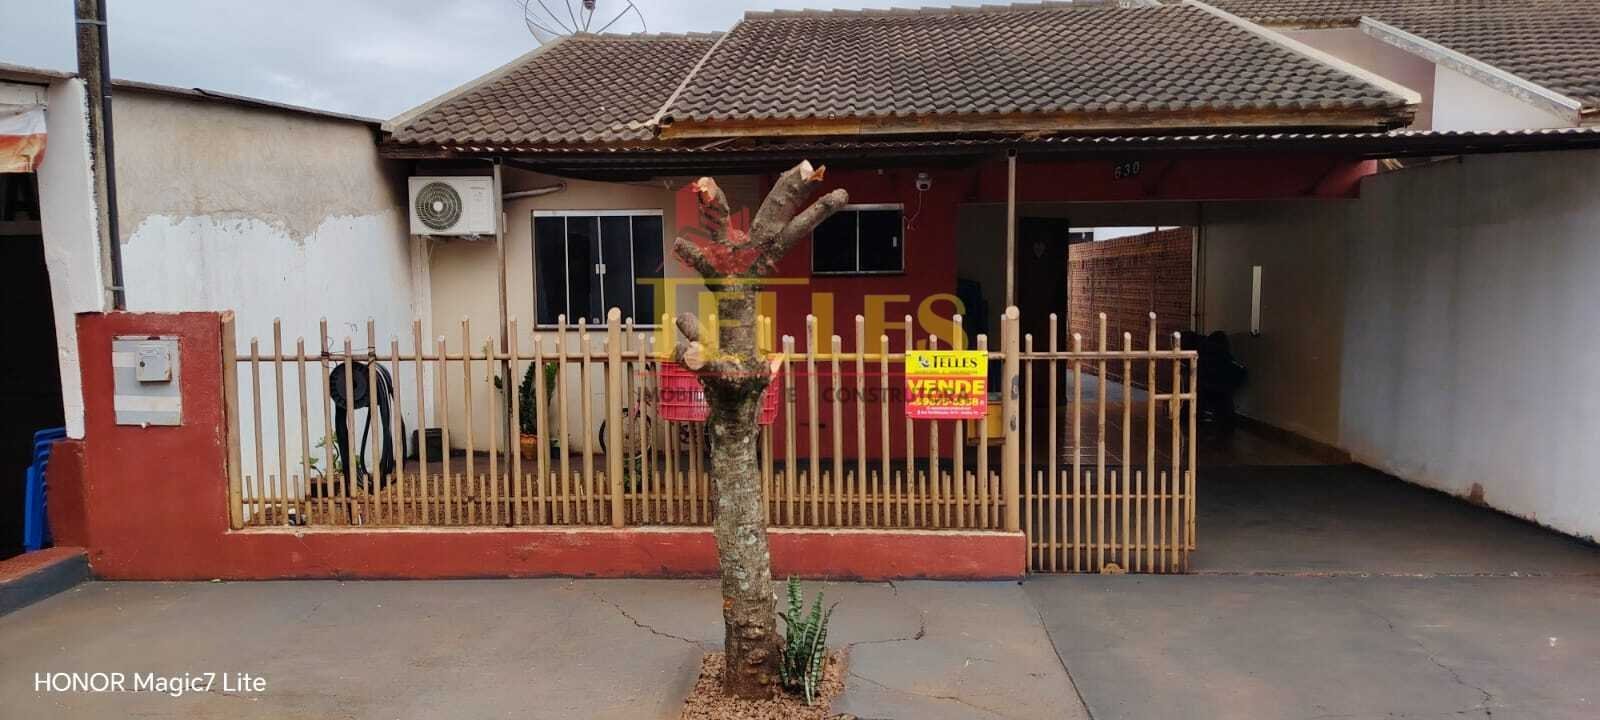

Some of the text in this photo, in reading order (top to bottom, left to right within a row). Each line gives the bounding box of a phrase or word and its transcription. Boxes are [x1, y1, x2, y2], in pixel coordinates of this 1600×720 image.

[1113, 161, 1141, 180] 630
[932, 355, 978, 368] TELLES
[907, 379, 986, 396] VENDE
